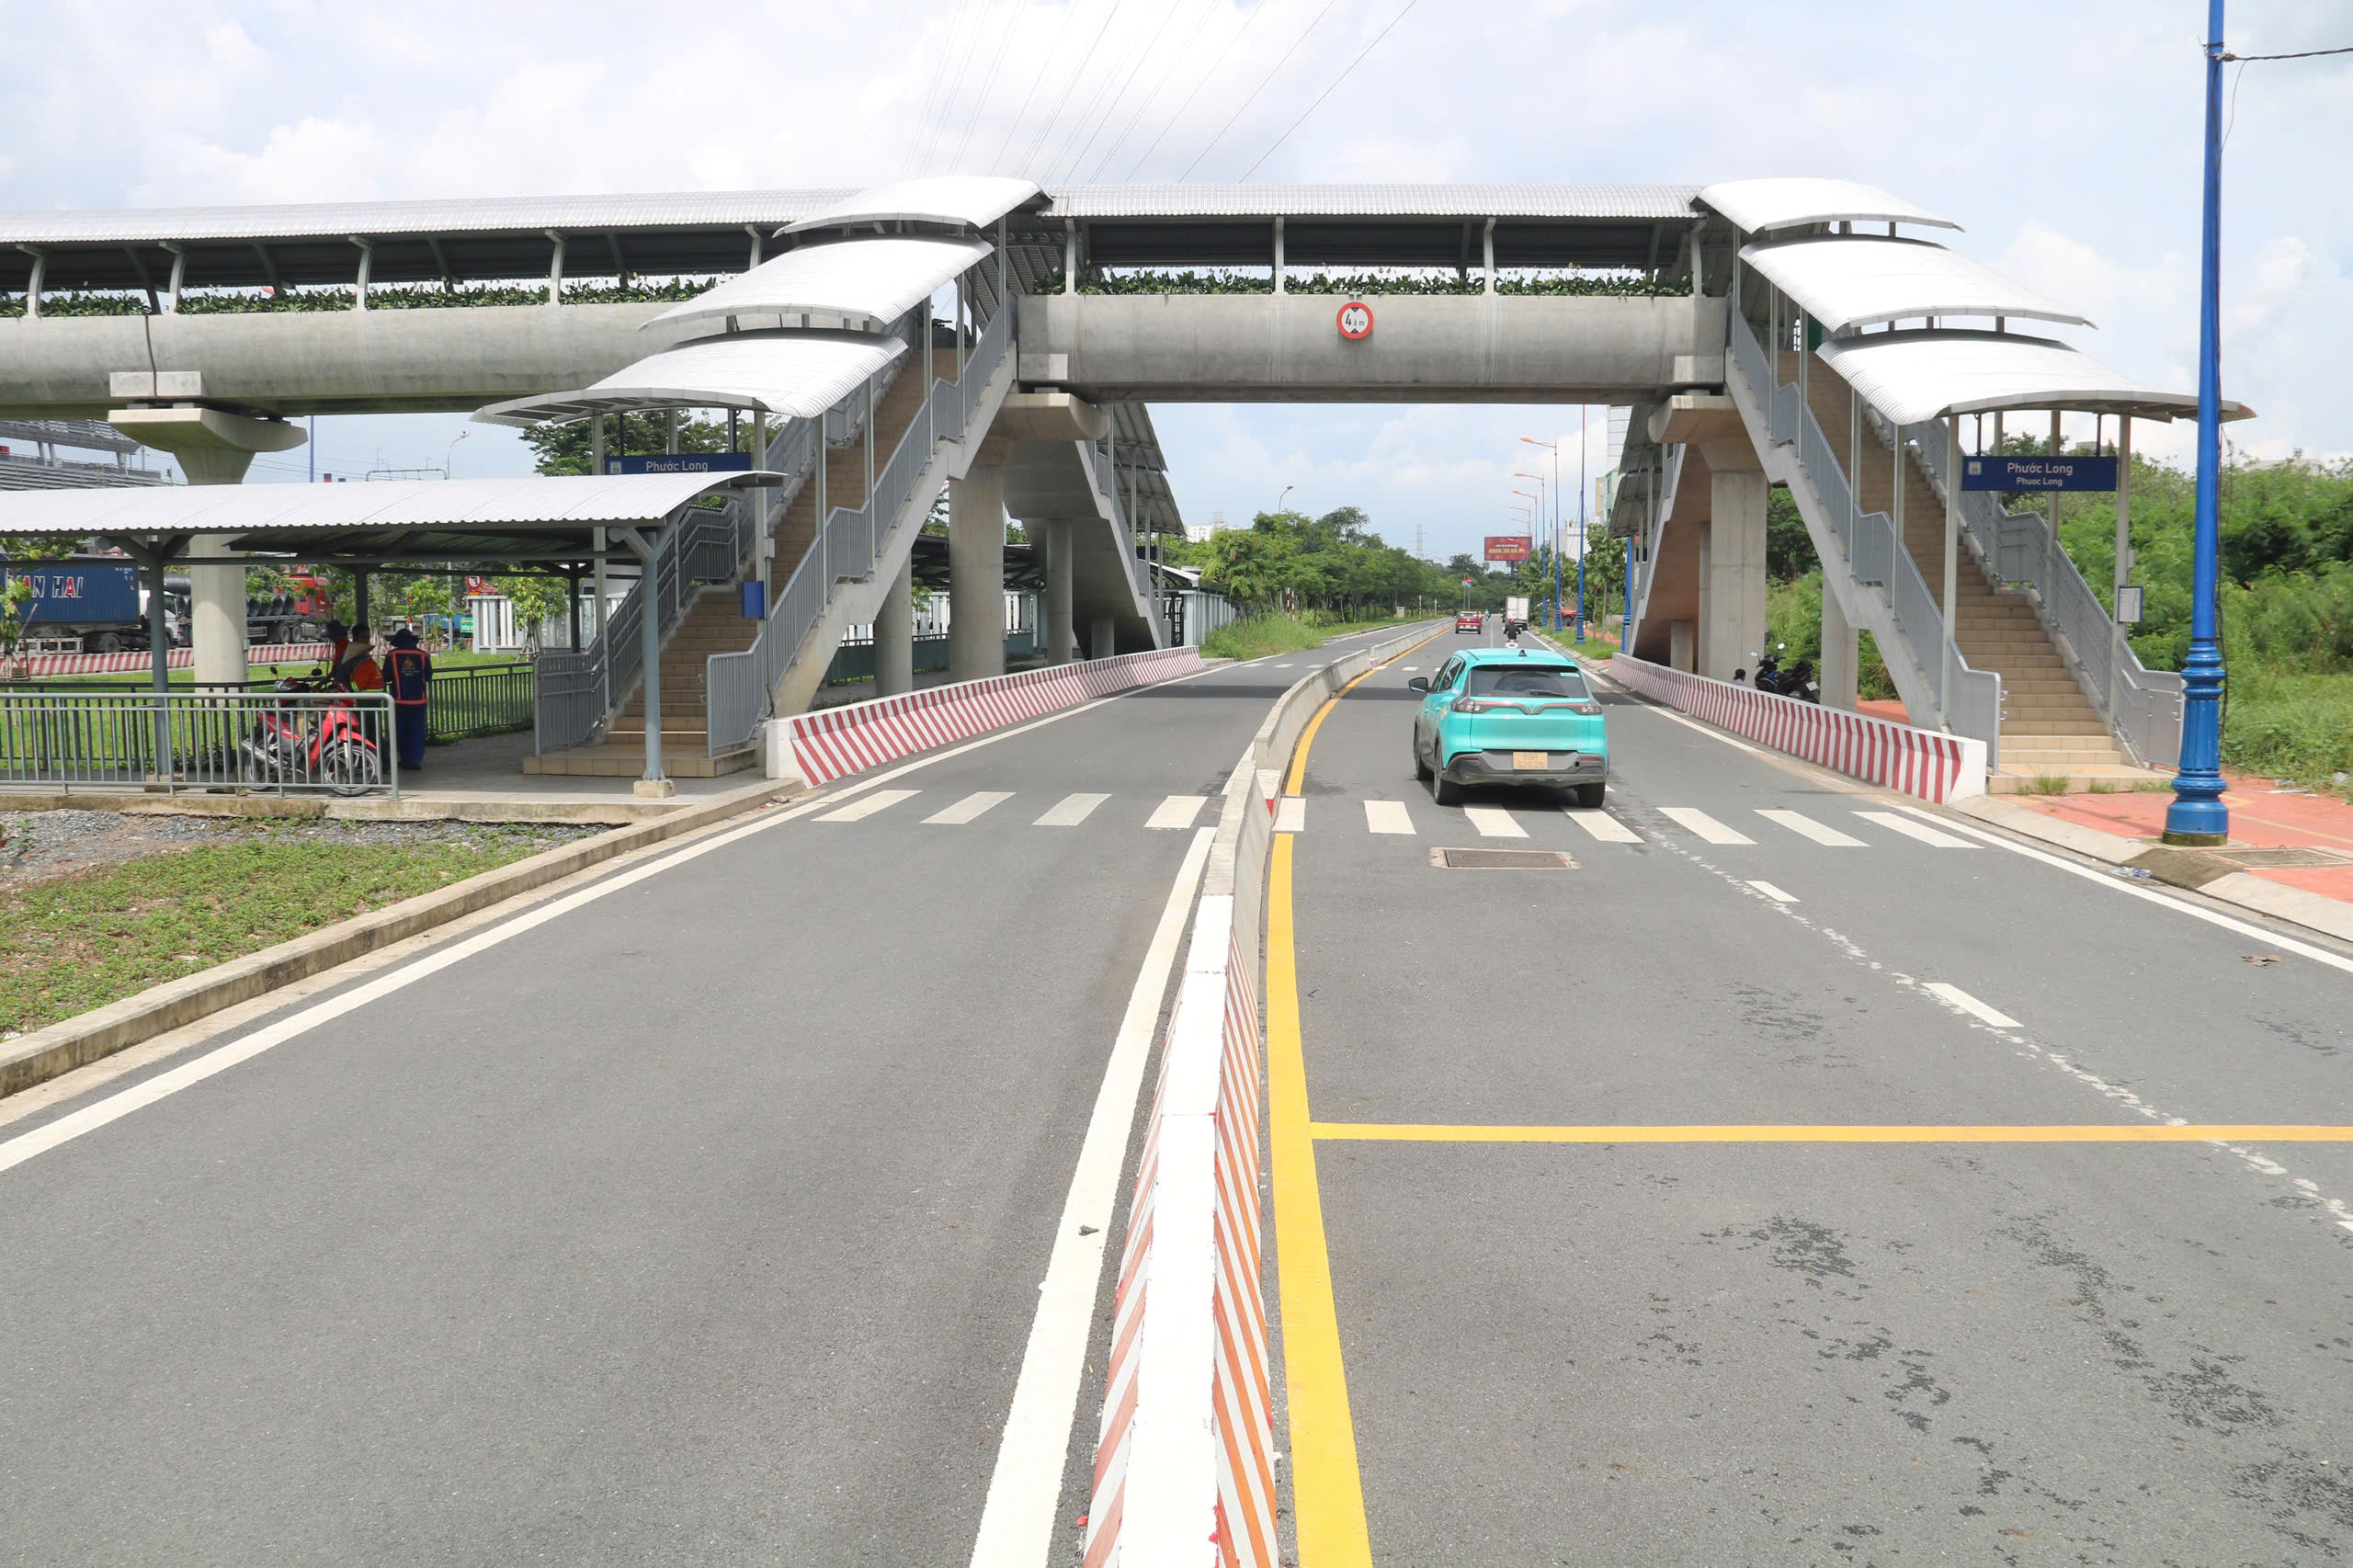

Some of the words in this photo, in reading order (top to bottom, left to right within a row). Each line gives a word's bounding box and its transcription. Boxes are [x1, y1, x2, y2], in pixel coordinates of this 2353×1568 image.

[646, 460, 679, 472] Phước
[682, 460, 708, 472] Long
[2007, 462, 2042, 473] Phước
[2045, 462, 2074, 476] Long
[2016, 477, 2041, 485] Phuoc
[2042, 477, 2063, 486] Long
[51, 576, 84, 598] HAI
